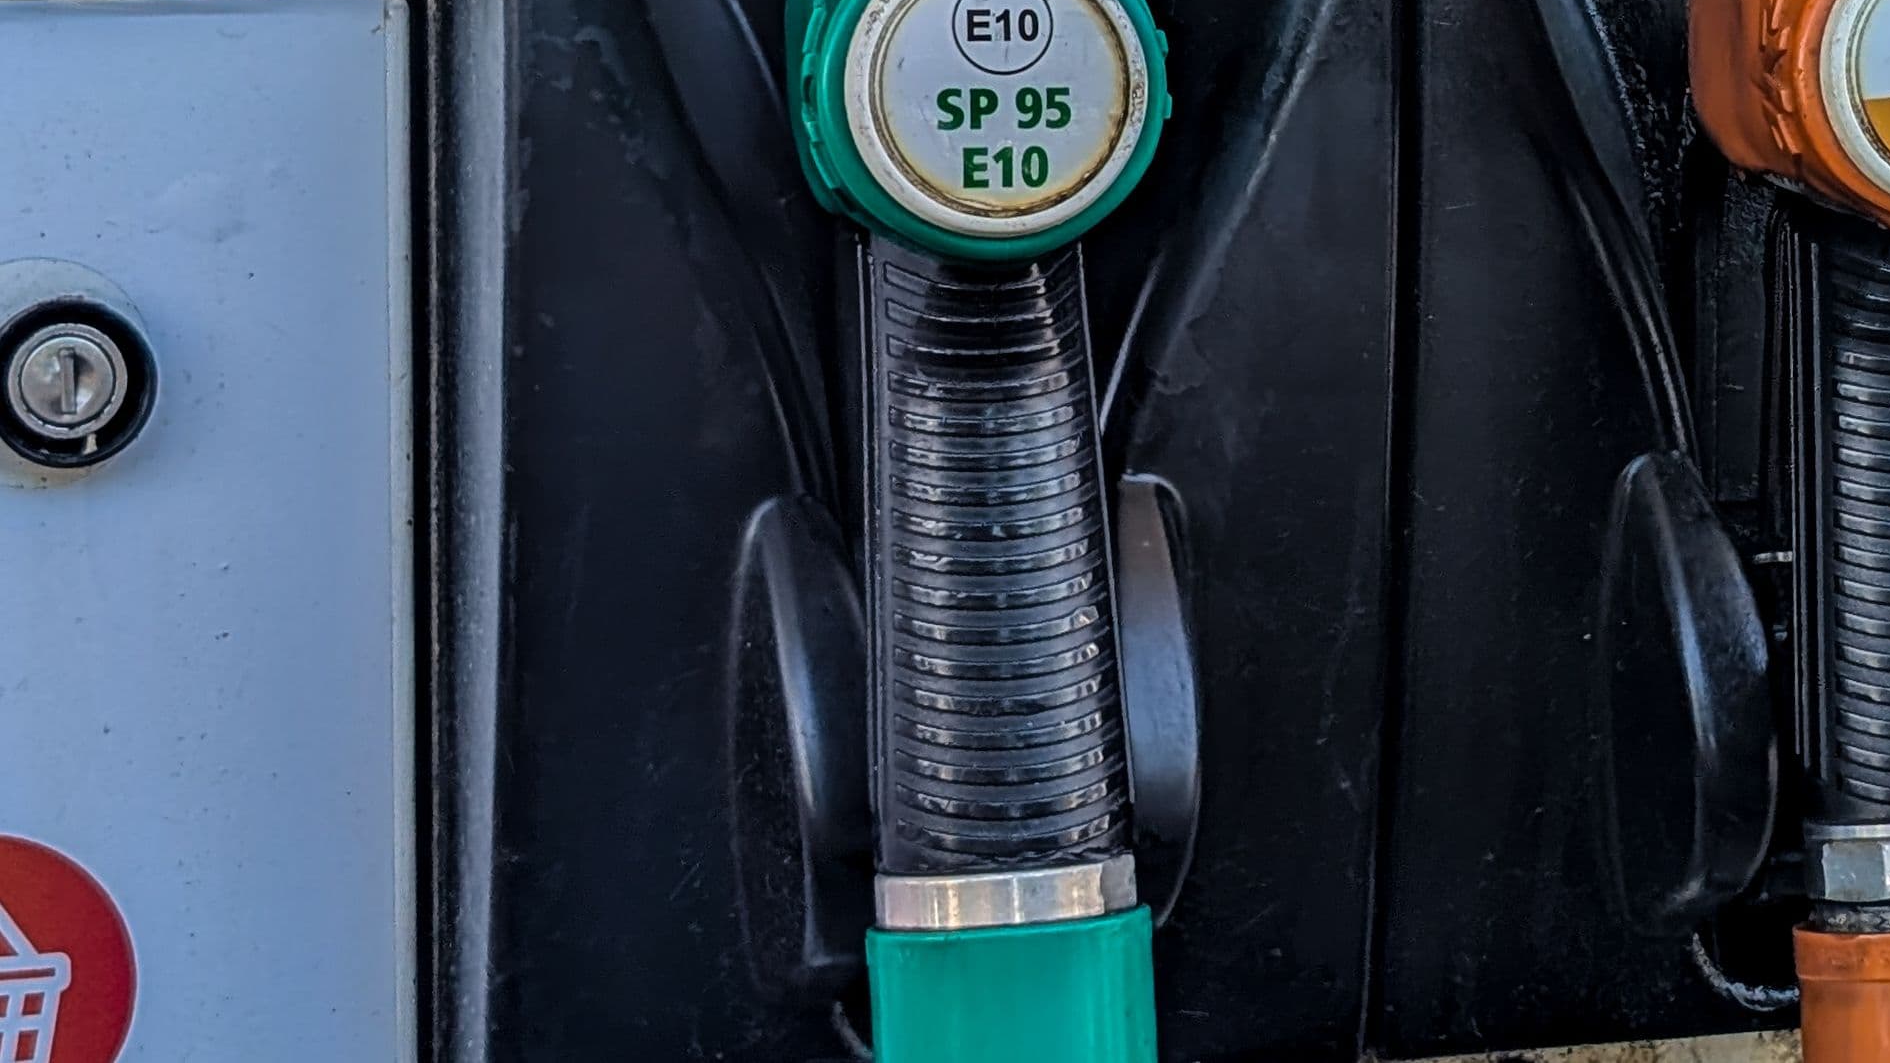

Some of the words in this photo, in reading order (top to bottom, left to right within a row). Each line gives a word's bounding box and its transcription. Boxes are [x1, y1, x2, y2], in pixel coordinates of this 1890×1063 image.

[965, 8, 1040, 42] E10
[936, 88, 998, 130] SP
[1016, 87, 1072, 130] 95
[962, 146, 1049, 189] E10
